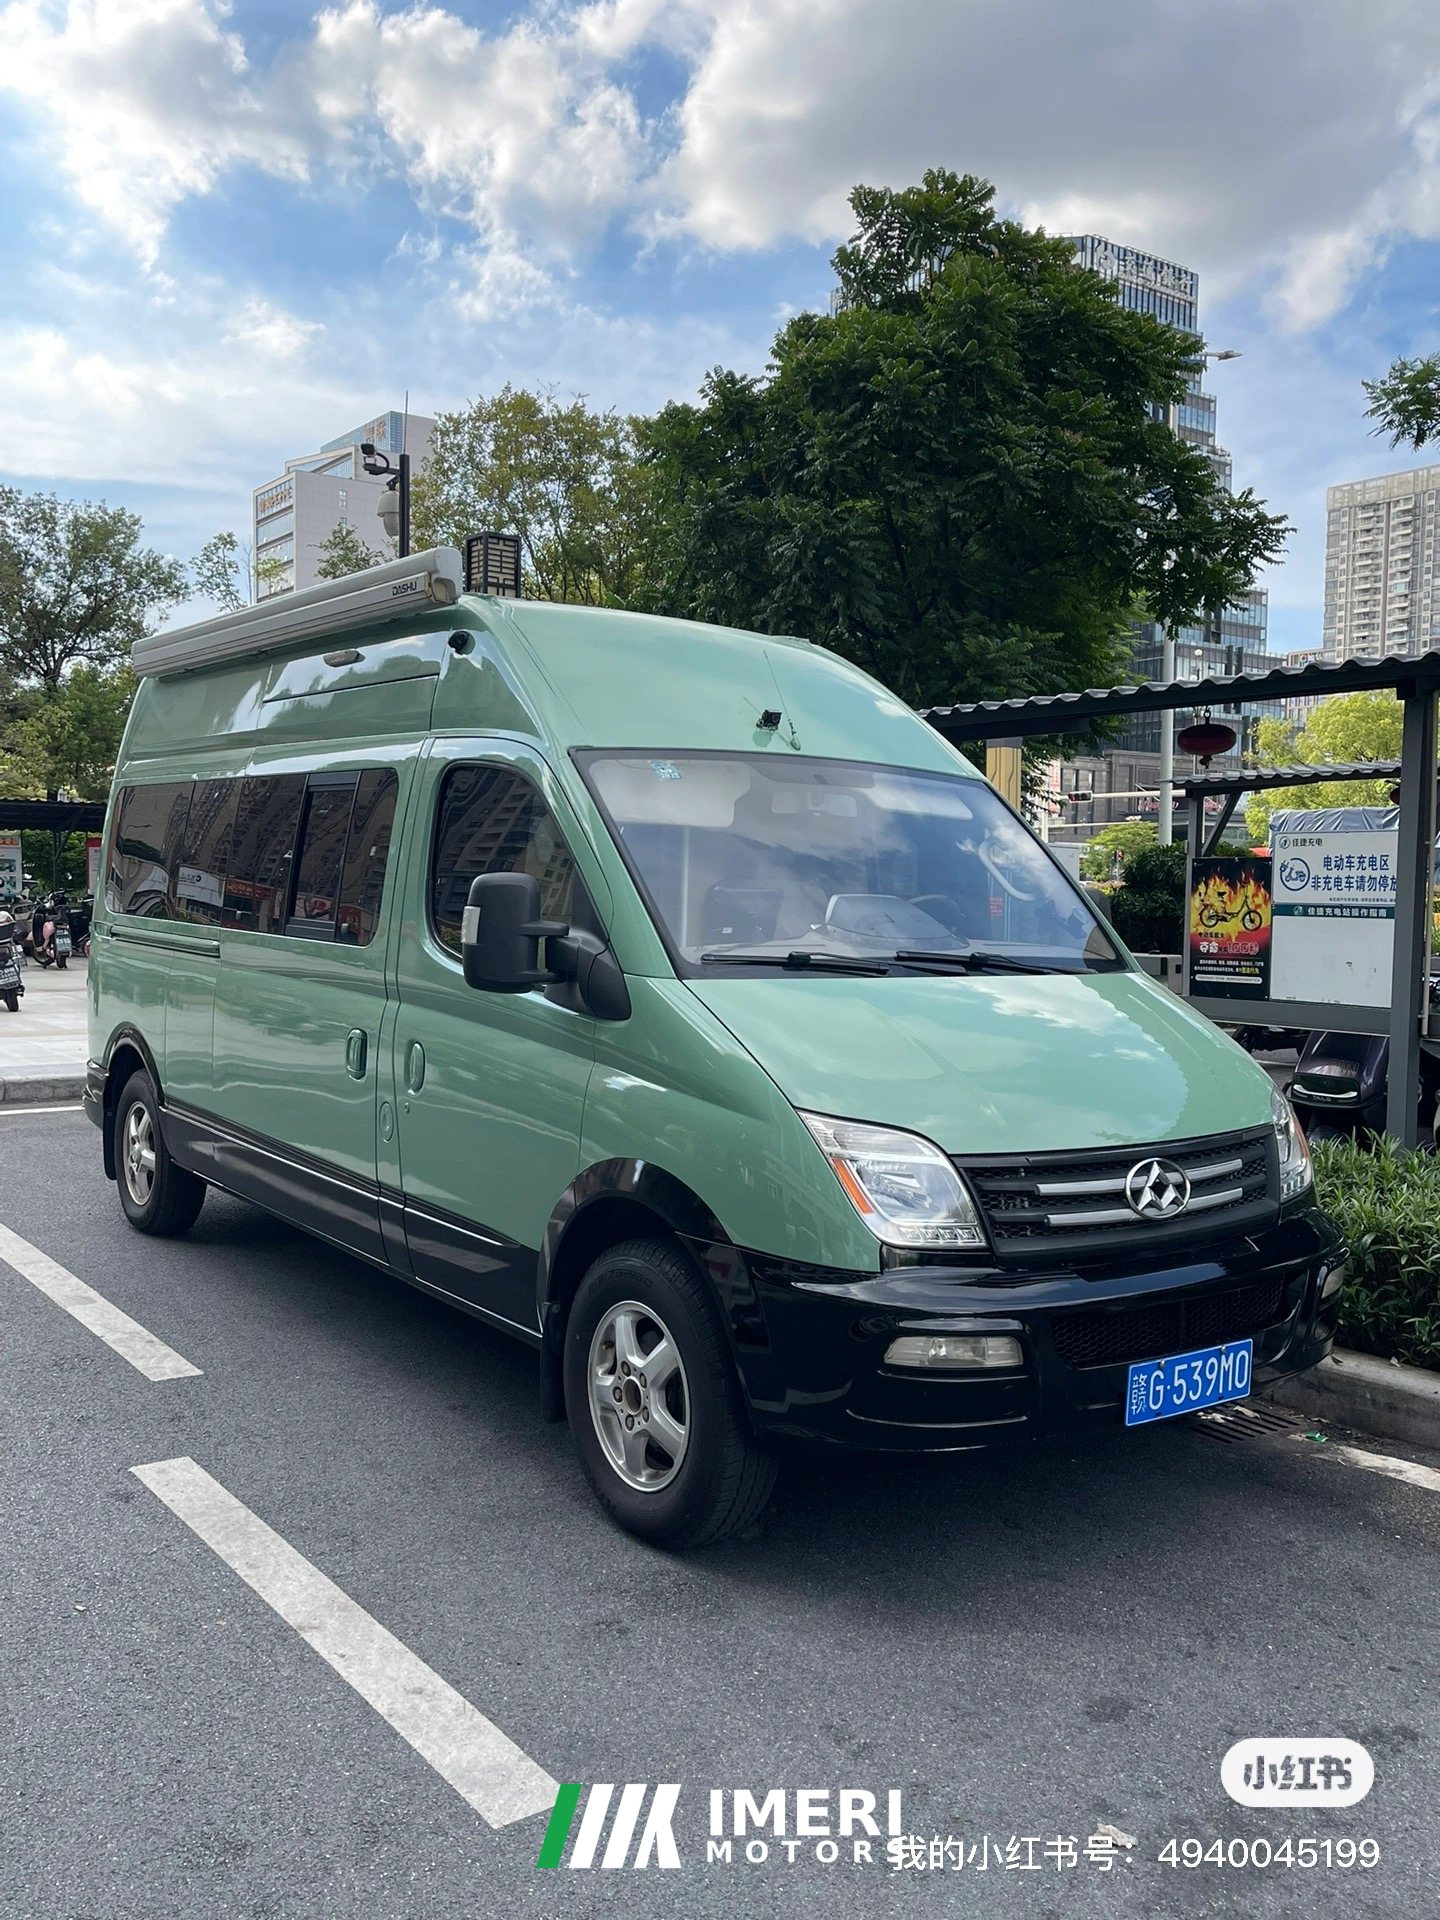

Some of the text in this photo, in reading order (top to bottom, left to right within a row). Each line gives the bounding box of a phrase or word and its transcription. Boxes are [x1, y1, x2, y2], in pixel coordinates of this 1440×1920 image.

[1292, 838, 1323, 847] 佳捷充电
[1323, 854, 1390, 871] 电动车充电区
[1307, 907, 1387, 917] 佳捷充电站操作指南
